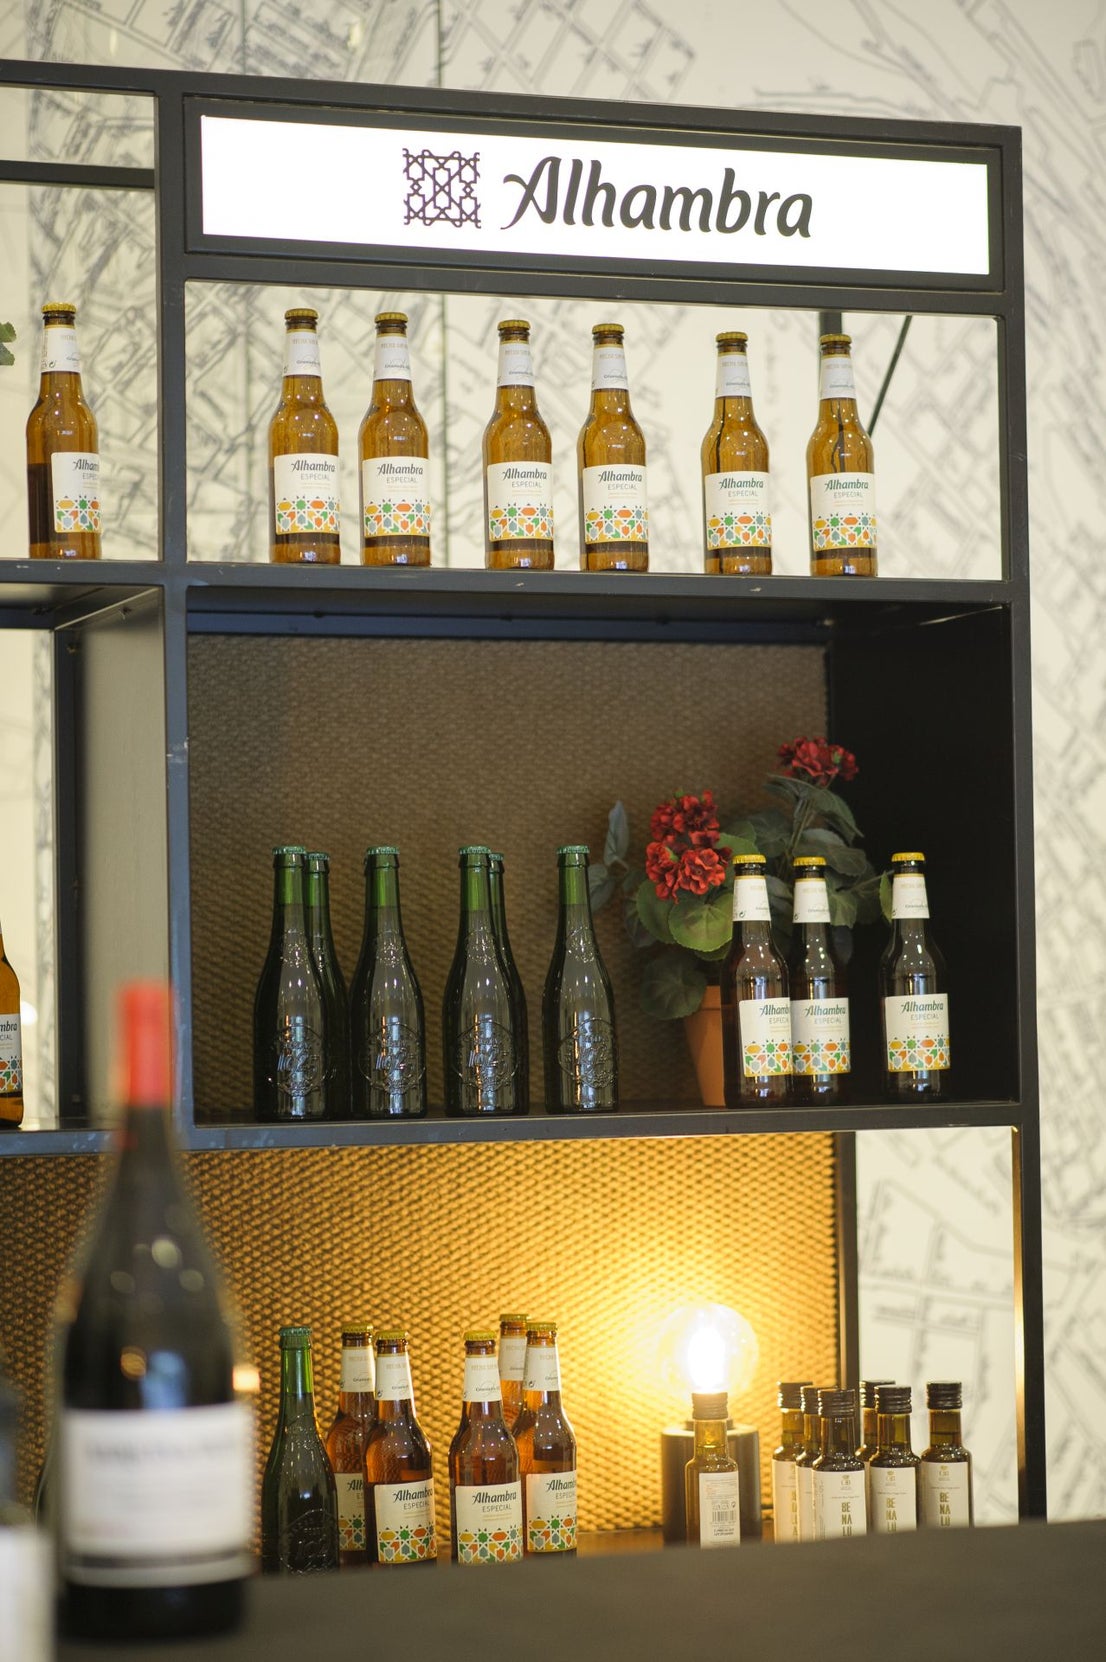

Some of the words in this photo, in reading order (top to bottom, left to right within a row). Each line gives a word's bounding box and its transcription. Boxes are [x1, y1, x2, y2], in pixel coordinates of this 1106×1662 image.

[502, 155, 813, 238] Alhambra
[291, 460, 335, 473] Alhambra
[377, 463, 424, 476] Alhambra
[301, 473, 330, 481] ESPECIAL
[386, 476, 418, 484] ESPECIAL
[502, 468, 547, 480] Alhambra
[598, 471, 643, 483] Alhambra
[511, 481, 542, 489] ESPECIAL
[607, 483, 637, 491] ESPECIAL
[719, 477, 764, 490] Alhambra
[824, 478, 869, 491] Alhambra
[728, 490, 759, 498] ESPECIAL
[833, 491, 863, 499] ESPECIAL
[759, 1003, 790, 1017] Alhamb
[805, 1003, 847, 1017] Alhambra
[900, 999, 945, 1014] Alhambra
[815, 1016, 842, 1025] ESPECIAL
[910, 1013, 940, 1021] ESPECIAL
[0, 1020, 18, 1032] mbra
[546, 1477, 577, 1492] Alhamb
[392, 1484, 433, 1503] Alhambra
[472, 1490, 517, 1505] Alhambra
[939, 1491, 950, 1503] BE
[482, 1503, 512, 1513] ESPECIAL
[841, 1501, 851, 1513] BE
[886, 1497, 896, 1509] BE
[939, 1503, 951, 1515] NA
[841, 1513, 852, 1525] NA
[886, 1510, 897, 1521] NA
